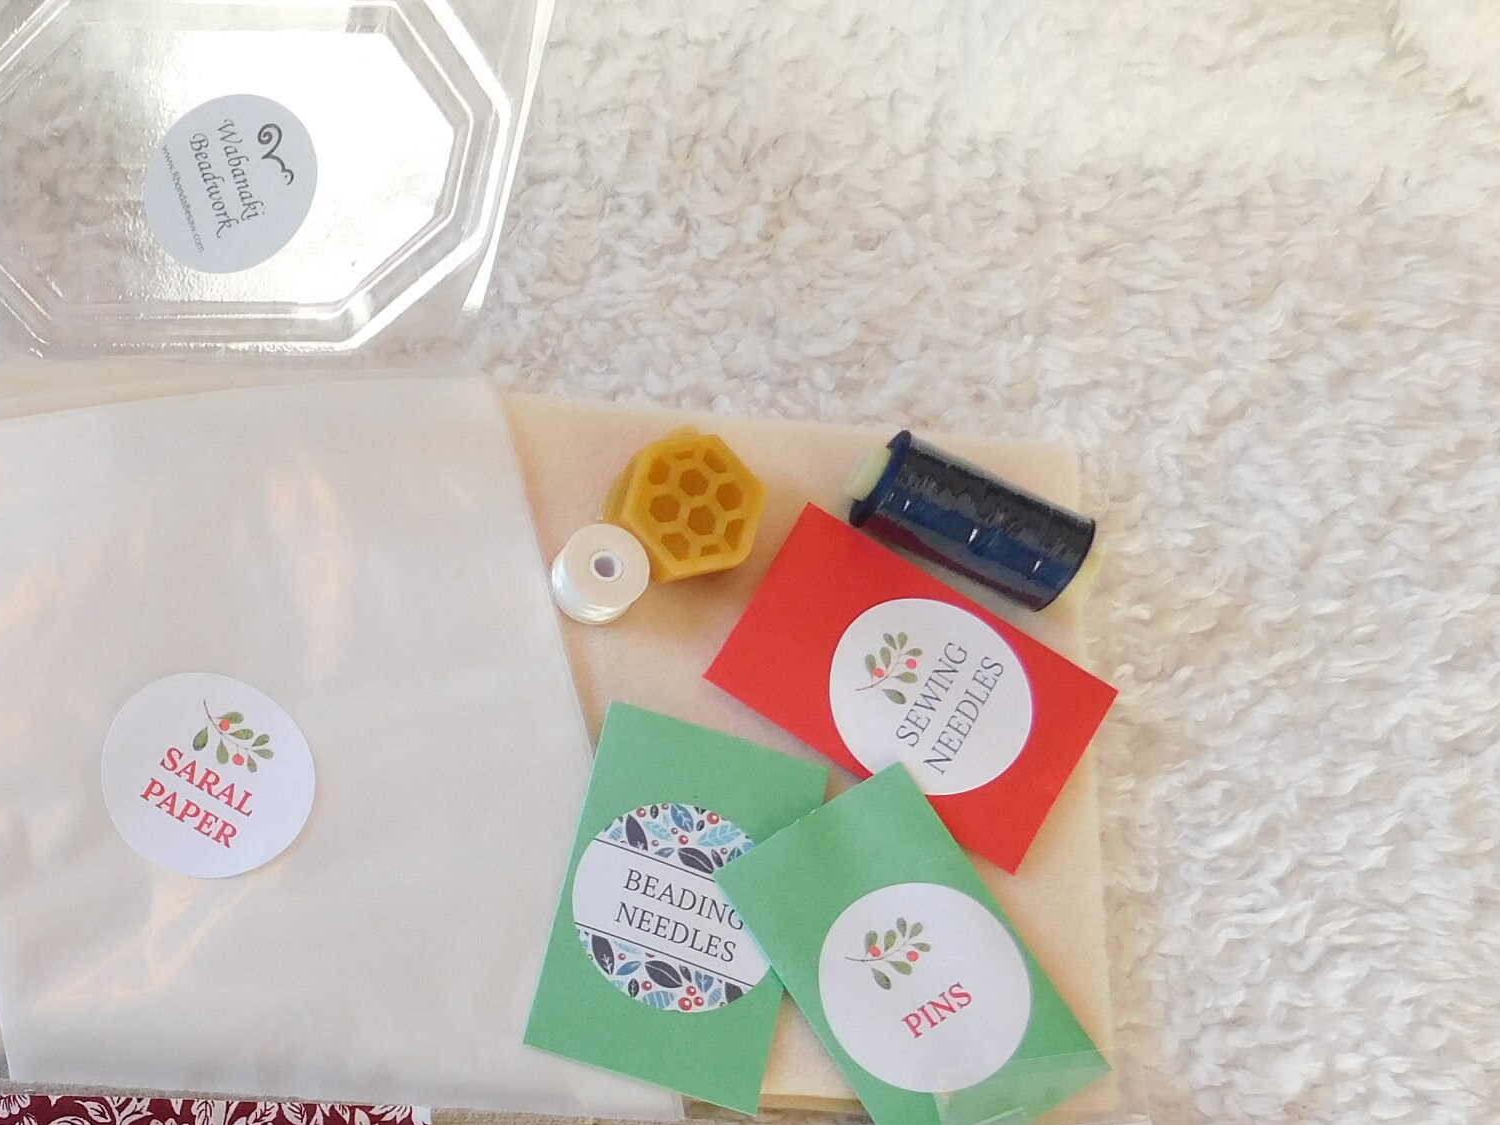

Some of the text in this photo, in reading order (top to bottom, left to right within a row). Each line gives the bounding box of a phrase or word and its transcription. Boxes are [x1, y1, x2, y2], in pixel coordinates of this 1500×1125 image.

[162, 145, 204, 253] www.RhondaBesaw.com
[189, 133, 240, 239] Beadwork
[217, 119, 265, 221] Wabanaki
[895, 642, 968, 749] SEWING
[922, 656, 1004, 775] NEEDLES
[140, 778, 238, 849] PAPER
[160, 747, 253, 817] SARAL
[614, 901, 737, 962] NEEDLES
[623, 868, 744, 931] BEADING
[901, 981, 972, 1039] PINS
